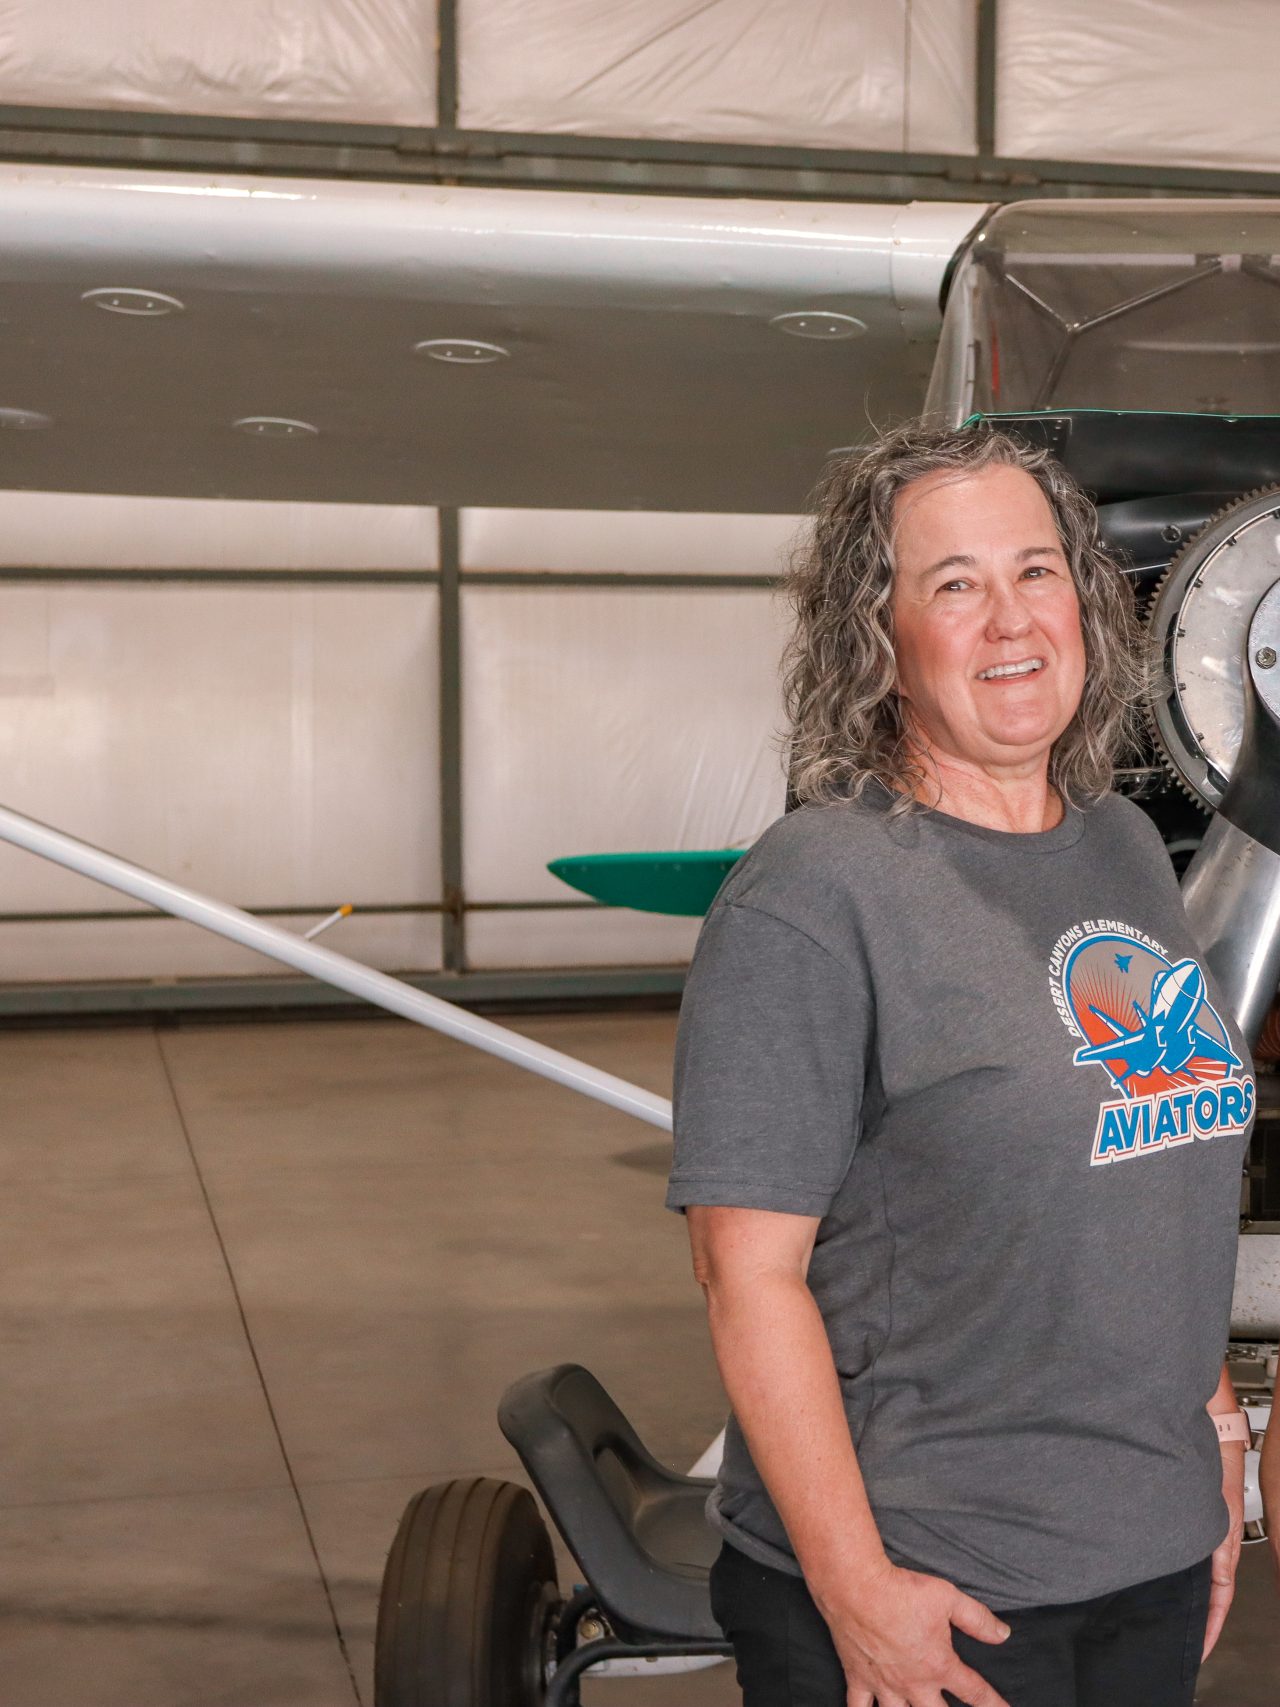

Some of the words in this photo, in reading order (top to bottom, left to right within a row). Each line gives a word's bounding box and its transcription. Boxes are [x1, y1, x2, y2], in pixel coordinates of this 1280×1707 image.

[1048, 925, 1084, 977] CANYONS
[1082, 919, 1169, 956] ELEMENTARY
[1048, 977, 1081, 1038] DESERT
[1094, 1078, 1256, 1161] AVIATORS
